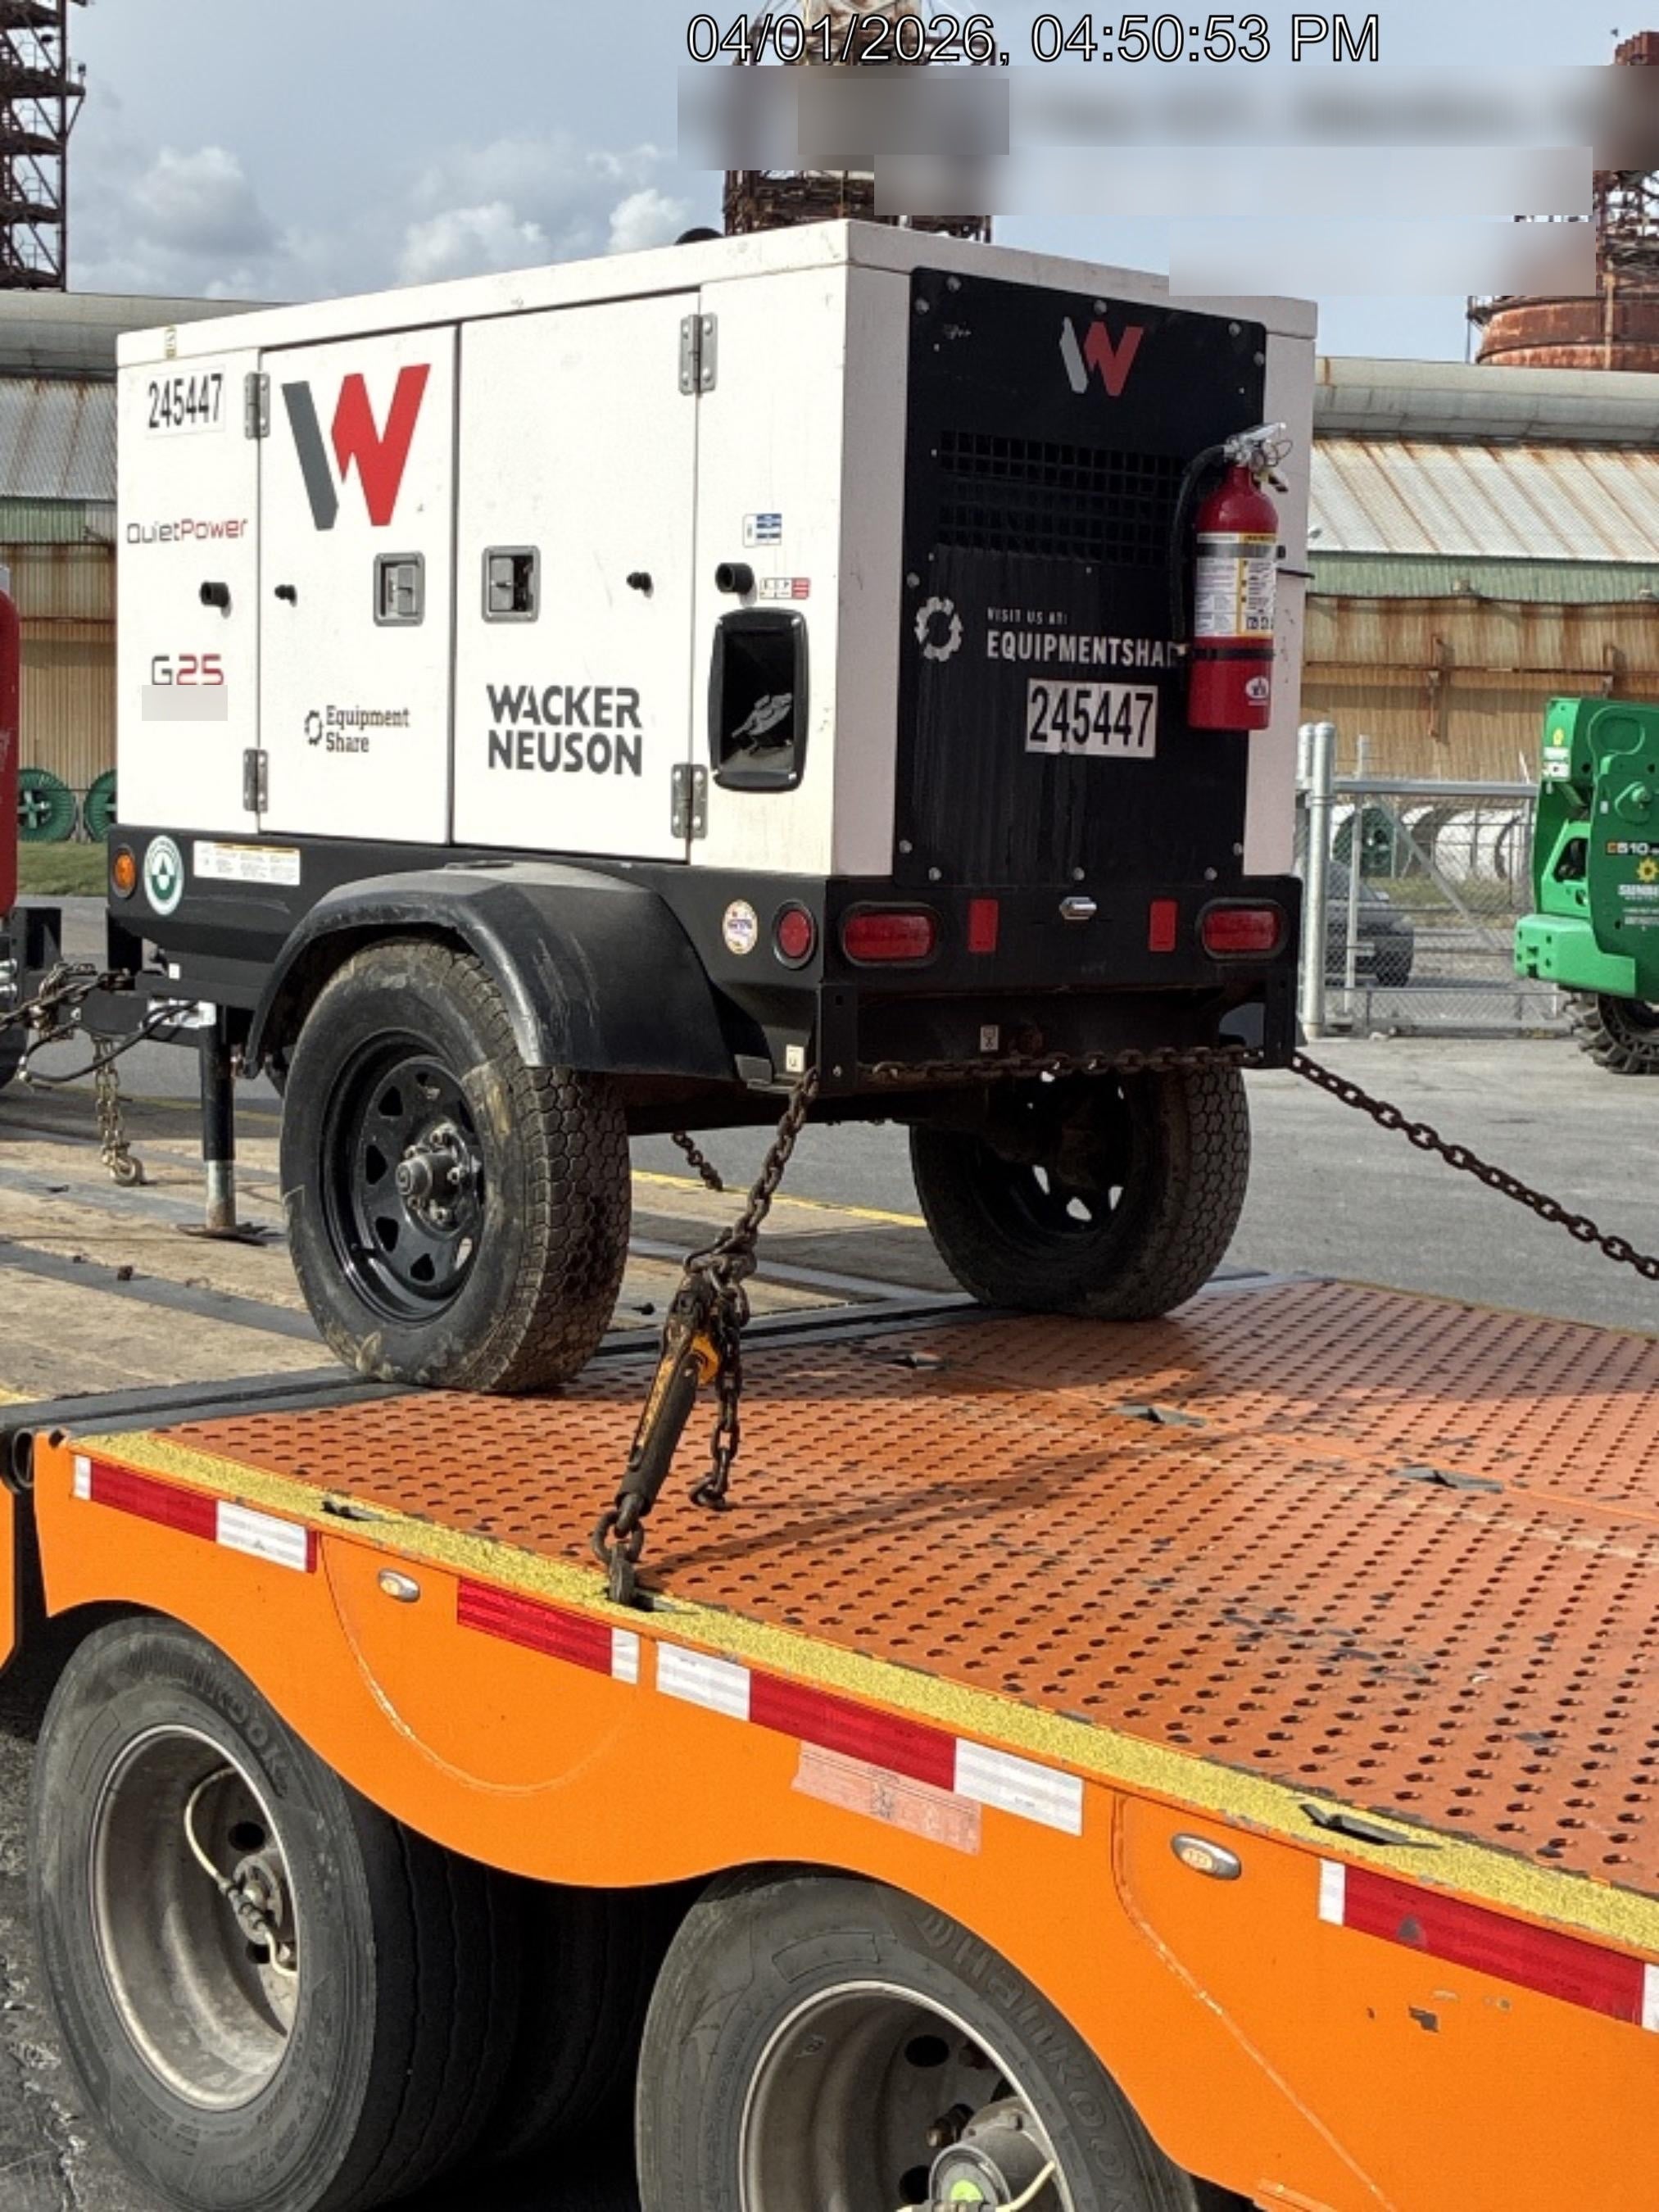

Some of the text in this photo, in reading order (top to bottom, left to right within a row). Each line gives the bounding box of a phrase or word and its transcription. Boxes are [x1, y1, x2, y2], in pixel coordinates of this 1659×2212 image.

[147, 374, 223, 428] 245447
[126, 518, 248, 544] QuietPower
[152, 654, 224, 685] G25
[326, 705, 410, 731] Equipment
[486, 682, 643, 729] WACKER
[1030, 686, 1154, 748] 245447
[326, 732, 369, 752] Share
[488, 728, 642, 777] NEUSON
